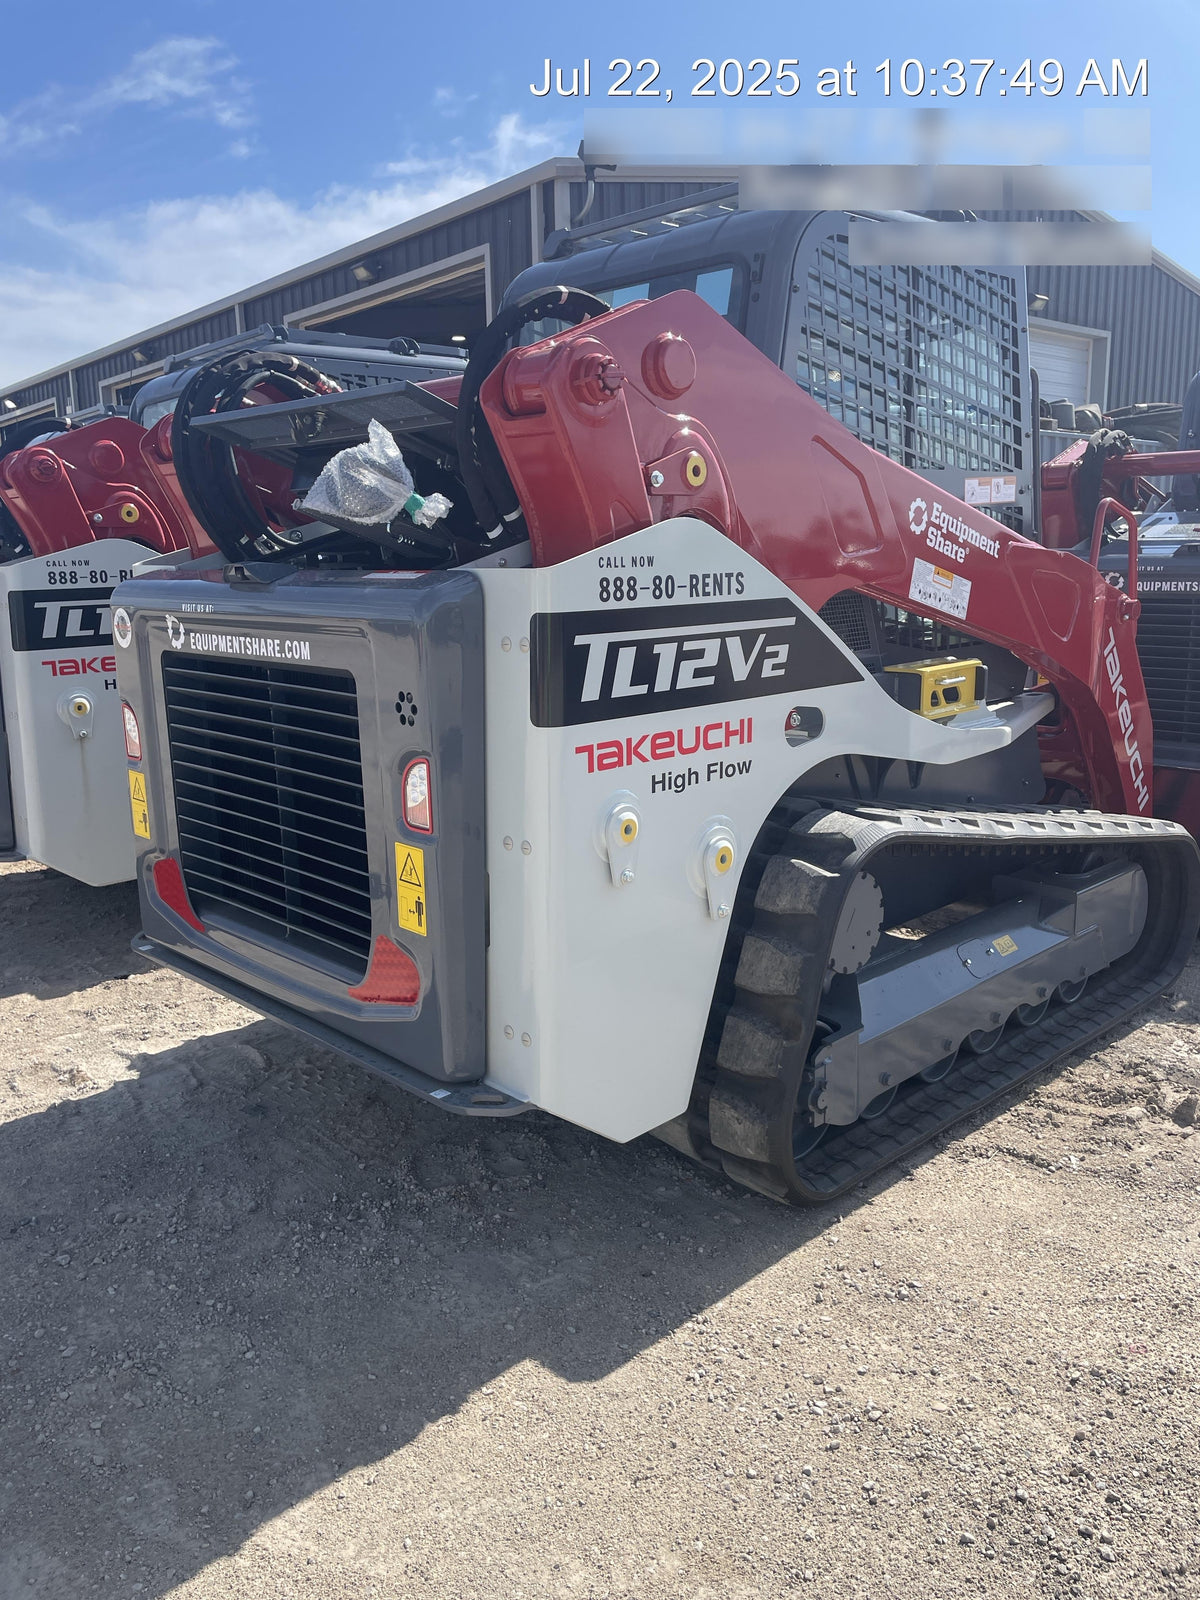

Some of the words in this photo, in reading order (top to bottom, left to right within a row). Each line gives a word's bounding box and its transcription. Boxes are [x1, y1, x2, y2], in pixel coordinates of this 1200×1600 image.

[931, 502, 1000, 558] Equipment
[598, 556, 626, 568] CALL
[631, 556, 655, 567] NOW
[599, 571, 745, 602] 888-80-RENTS
[1136, 581, 1200, 592] QUIPMENTS
[181, 603, 195, 612] VISIT
[197, 604, 204, 612] US
[190, 633, 311, 660] EQUIPMENTSHARE.COM
[573, 616, 797, 703] TL12V2
[1103, 626, 1150, 812] TAKEUCHI
[575, 717, 753, 773] TAKEUCHI
[651, 768, 699, 793] High
[706, 760, 752, 781] Flow
